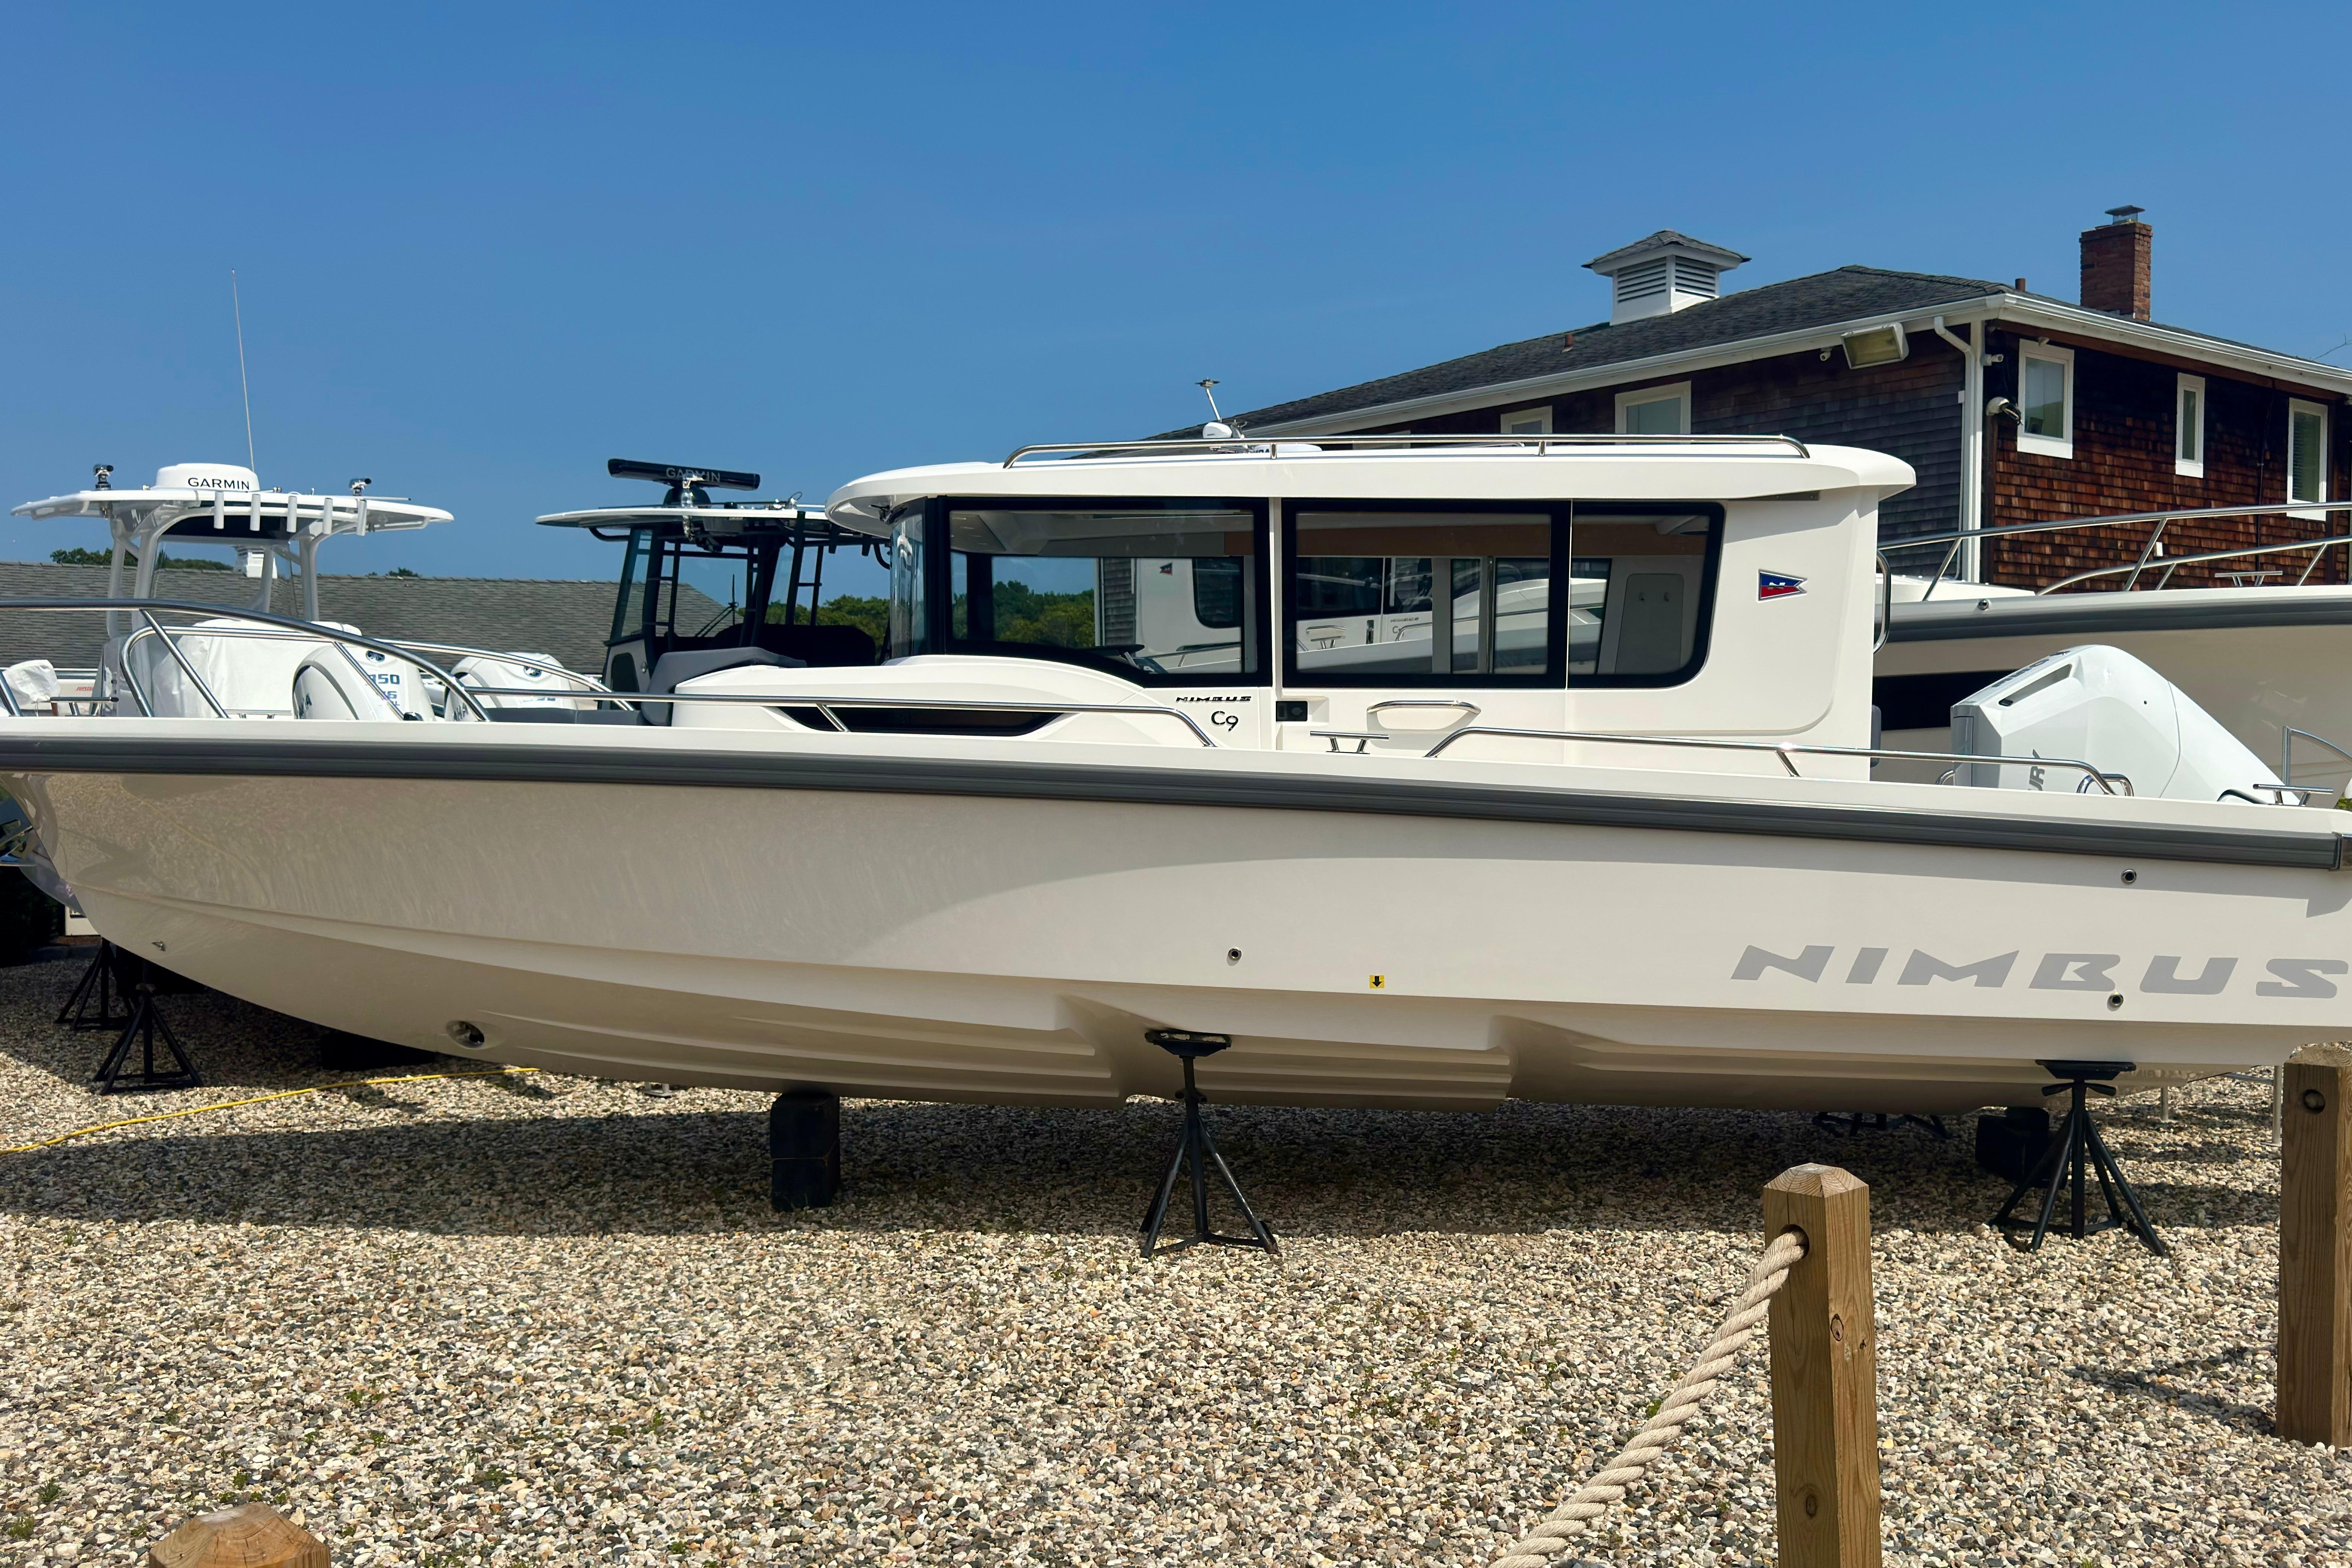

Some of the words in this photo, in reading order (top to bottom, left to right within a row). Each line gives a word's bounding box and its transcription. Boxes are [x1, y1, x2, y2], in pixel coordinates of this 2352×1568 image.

[188, 477, 249, 490] GARMIN
[1211, 710, 1239, 732] C9
[1730, 945, 2349, 999] NIMBUS
